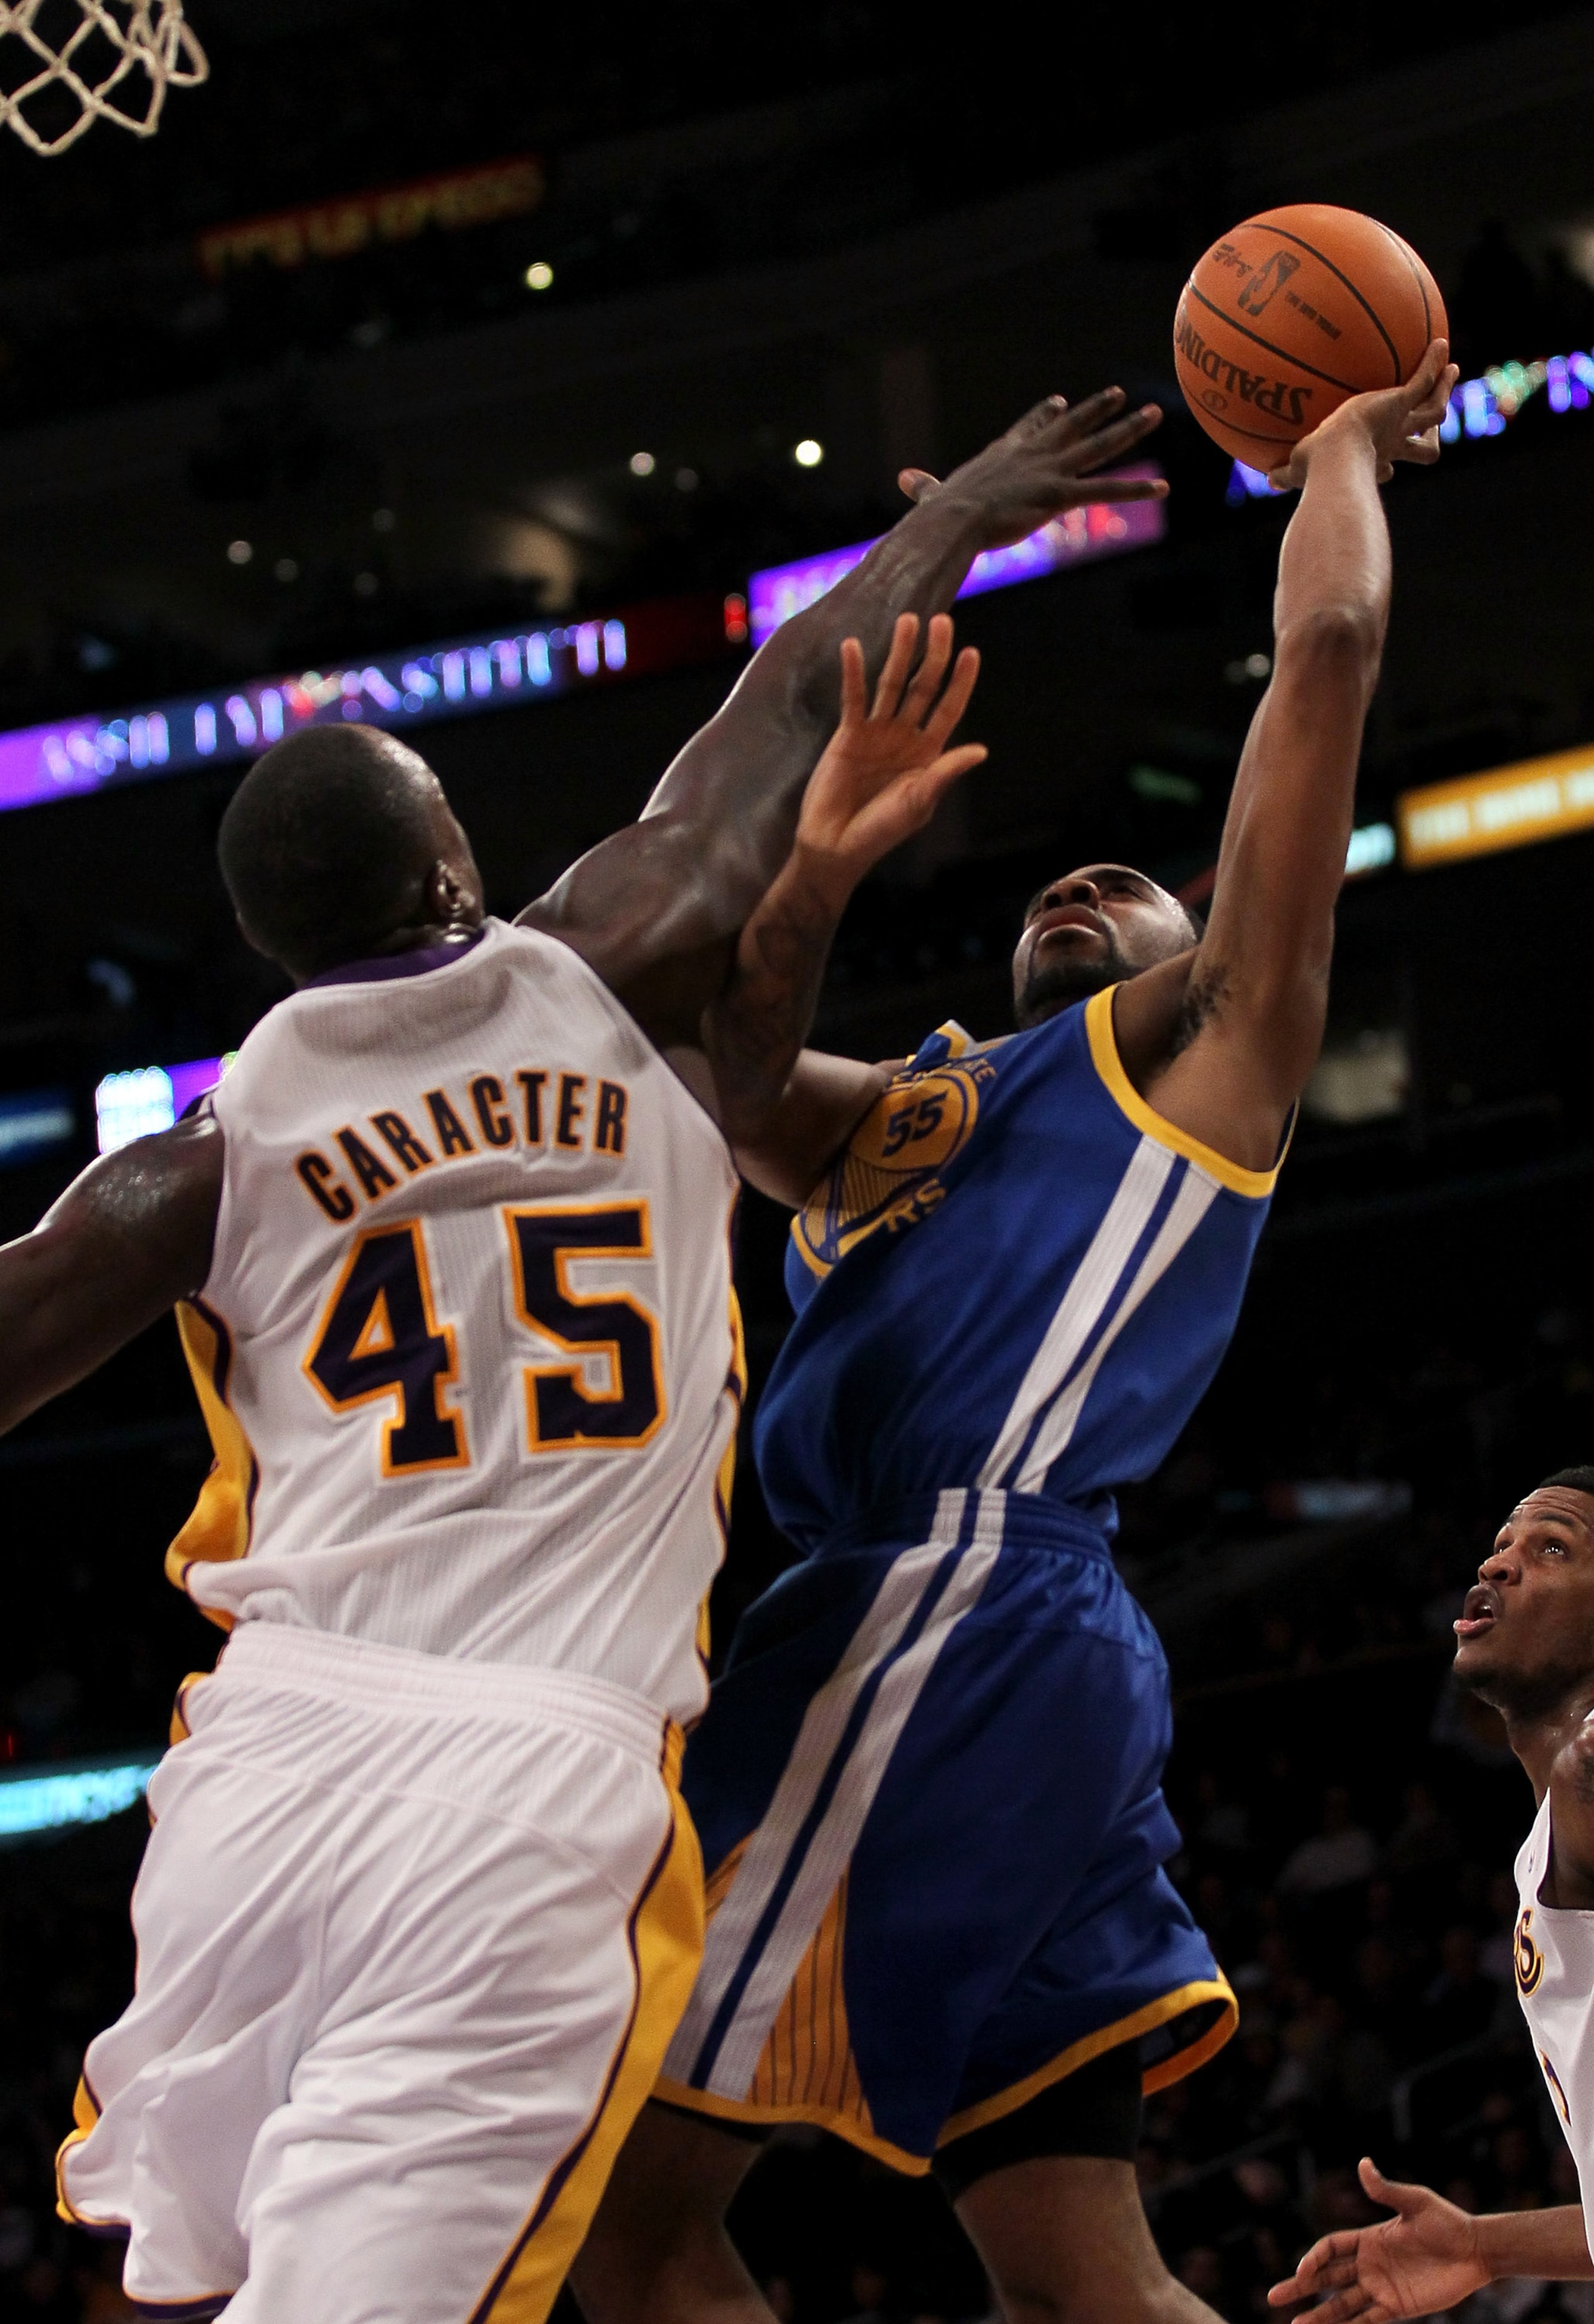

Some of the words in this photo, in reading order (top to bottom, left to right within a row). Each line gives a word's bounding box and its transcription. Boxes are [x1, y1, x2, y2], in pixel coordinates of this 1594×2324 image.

[1177, 316, 1315, 425] SPALDIN
[294, 1069, 628, 1223] CARACTER
[882, 1090, 950, 1158] 55
[301, 1199, 667, 1480] 45
